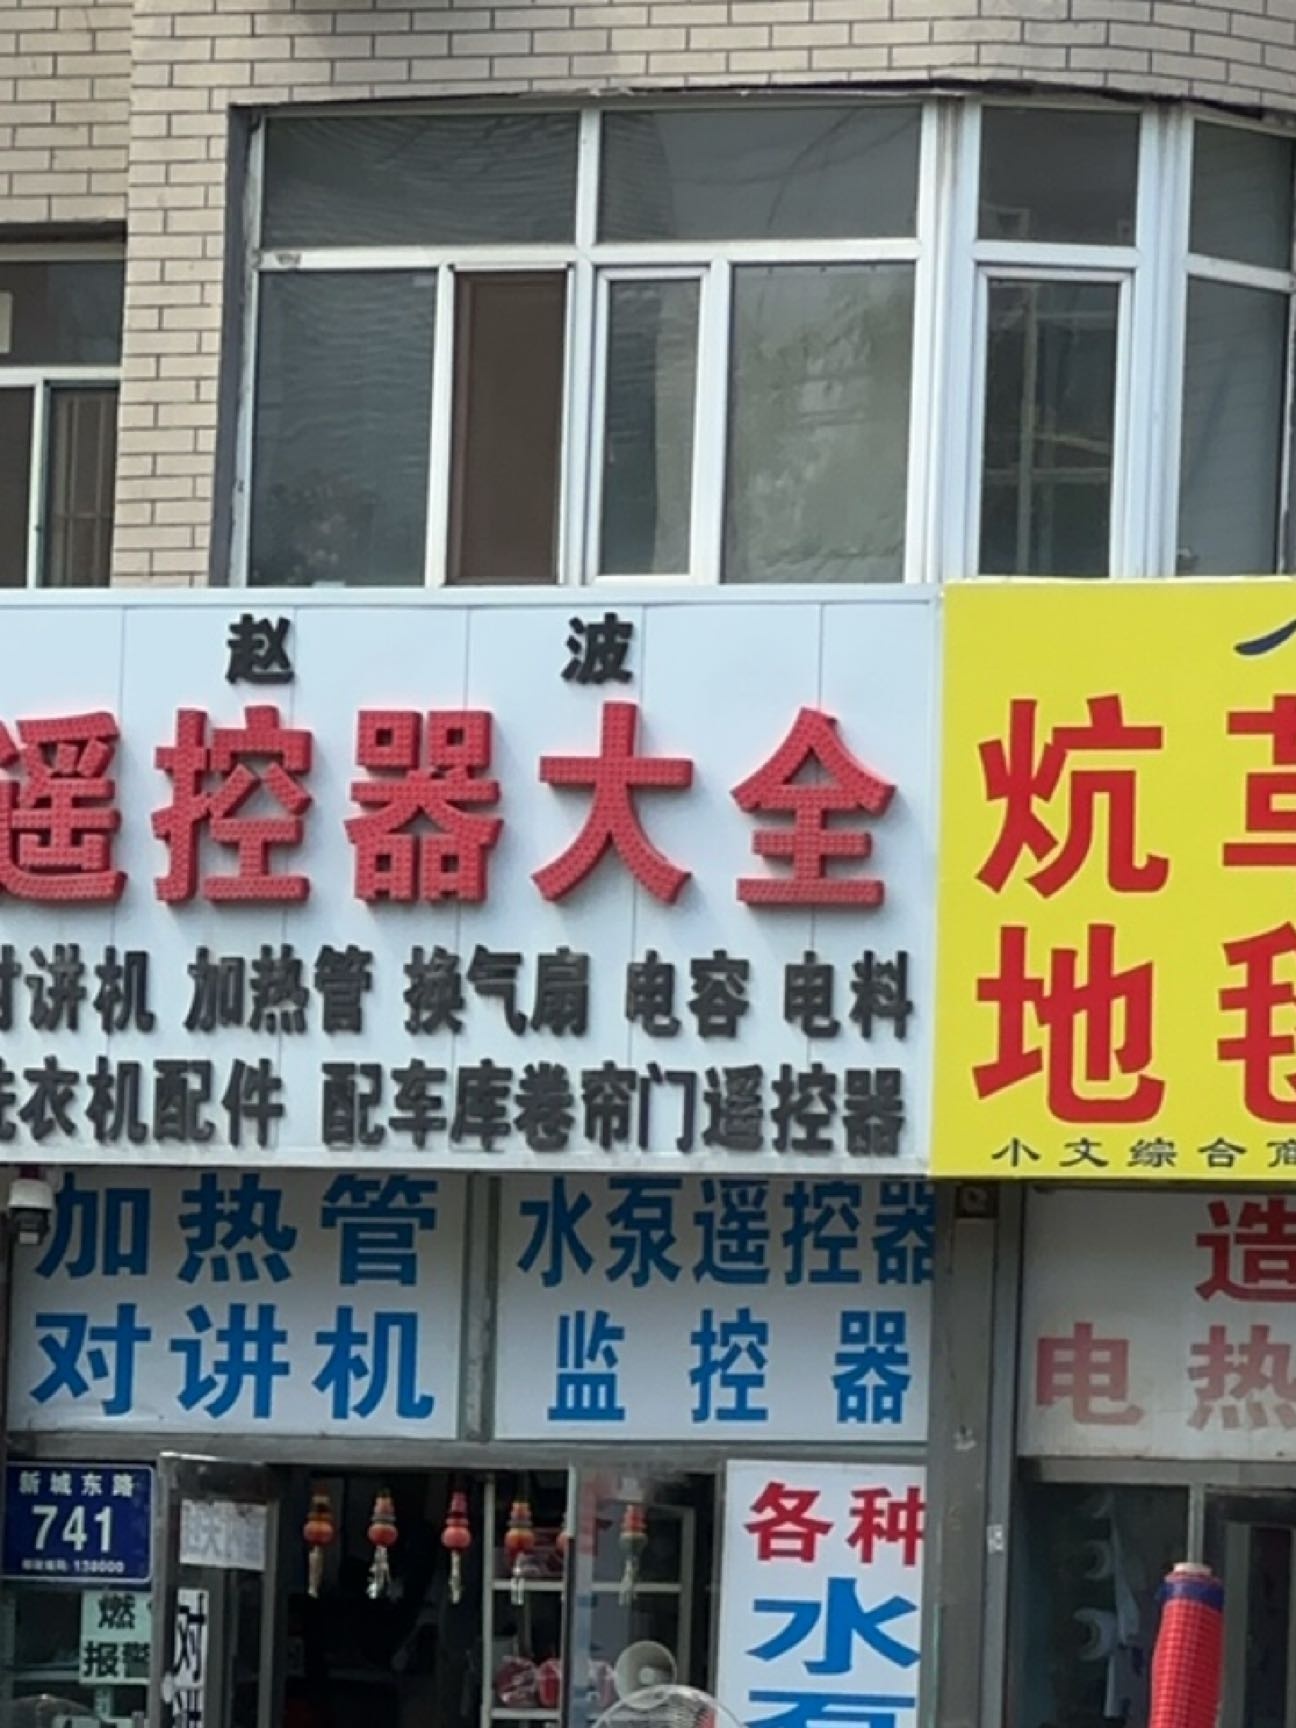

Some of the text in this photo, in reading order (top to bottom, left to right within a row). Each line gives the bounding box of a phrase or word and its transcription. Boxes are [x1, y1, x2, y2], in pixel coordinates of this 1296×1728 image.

[225, 612, 635, 685] 赵波
[0, 702, 895, 907] 遥控器大全
[184, 943, 374, 1036] 加热管
[404, 944, 590, 1038] 换气扇
[626, 949, 750, 1038] 电容
[784, 950, 914, 1040] 电料
[35, 1172, 438, 1287] 加热管
[517, 1177, 936, 1288] 水泵遥控器
[30, 1303, 436, 1421] 对讲机
[547, 1308, 912, 1424] 监控器
[19, 1470, 134, 1497] 新城东路
[32, 1504, 113, 1553] 741
[746, 1480, 926, 1566] 各种
